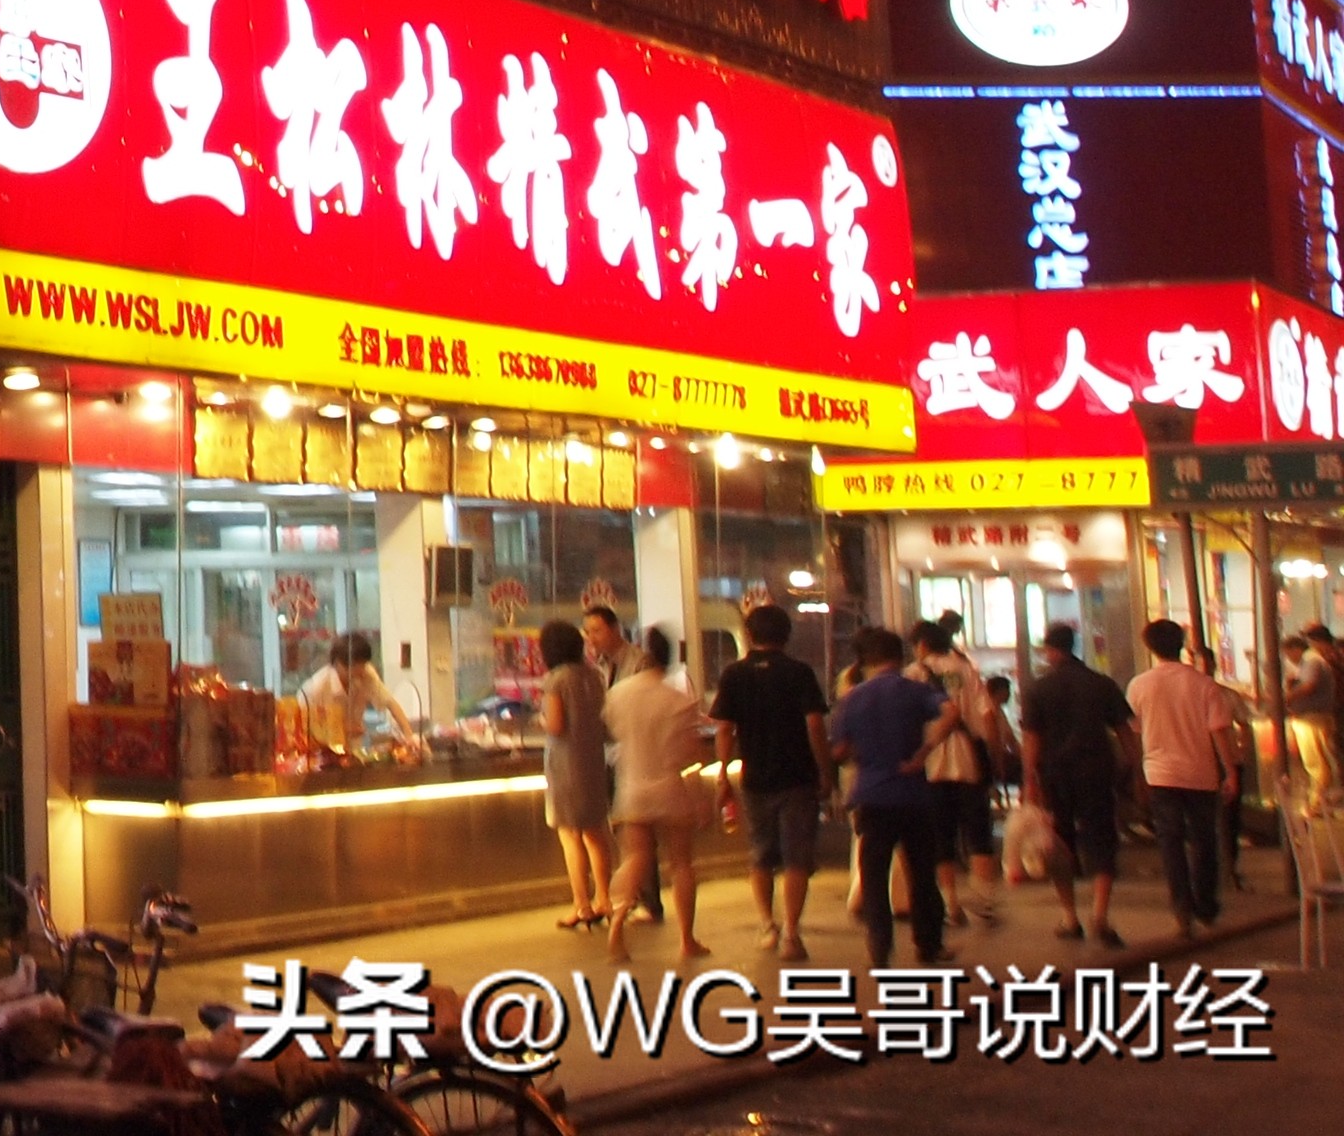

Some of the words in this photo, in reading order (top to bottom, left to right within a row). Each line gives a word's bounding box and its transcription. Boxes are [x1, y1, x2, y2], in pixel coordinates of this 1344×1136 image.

[1016, 99, 1090, 290] 武汉总店
[917, 323, 1245, 420] 武人家
